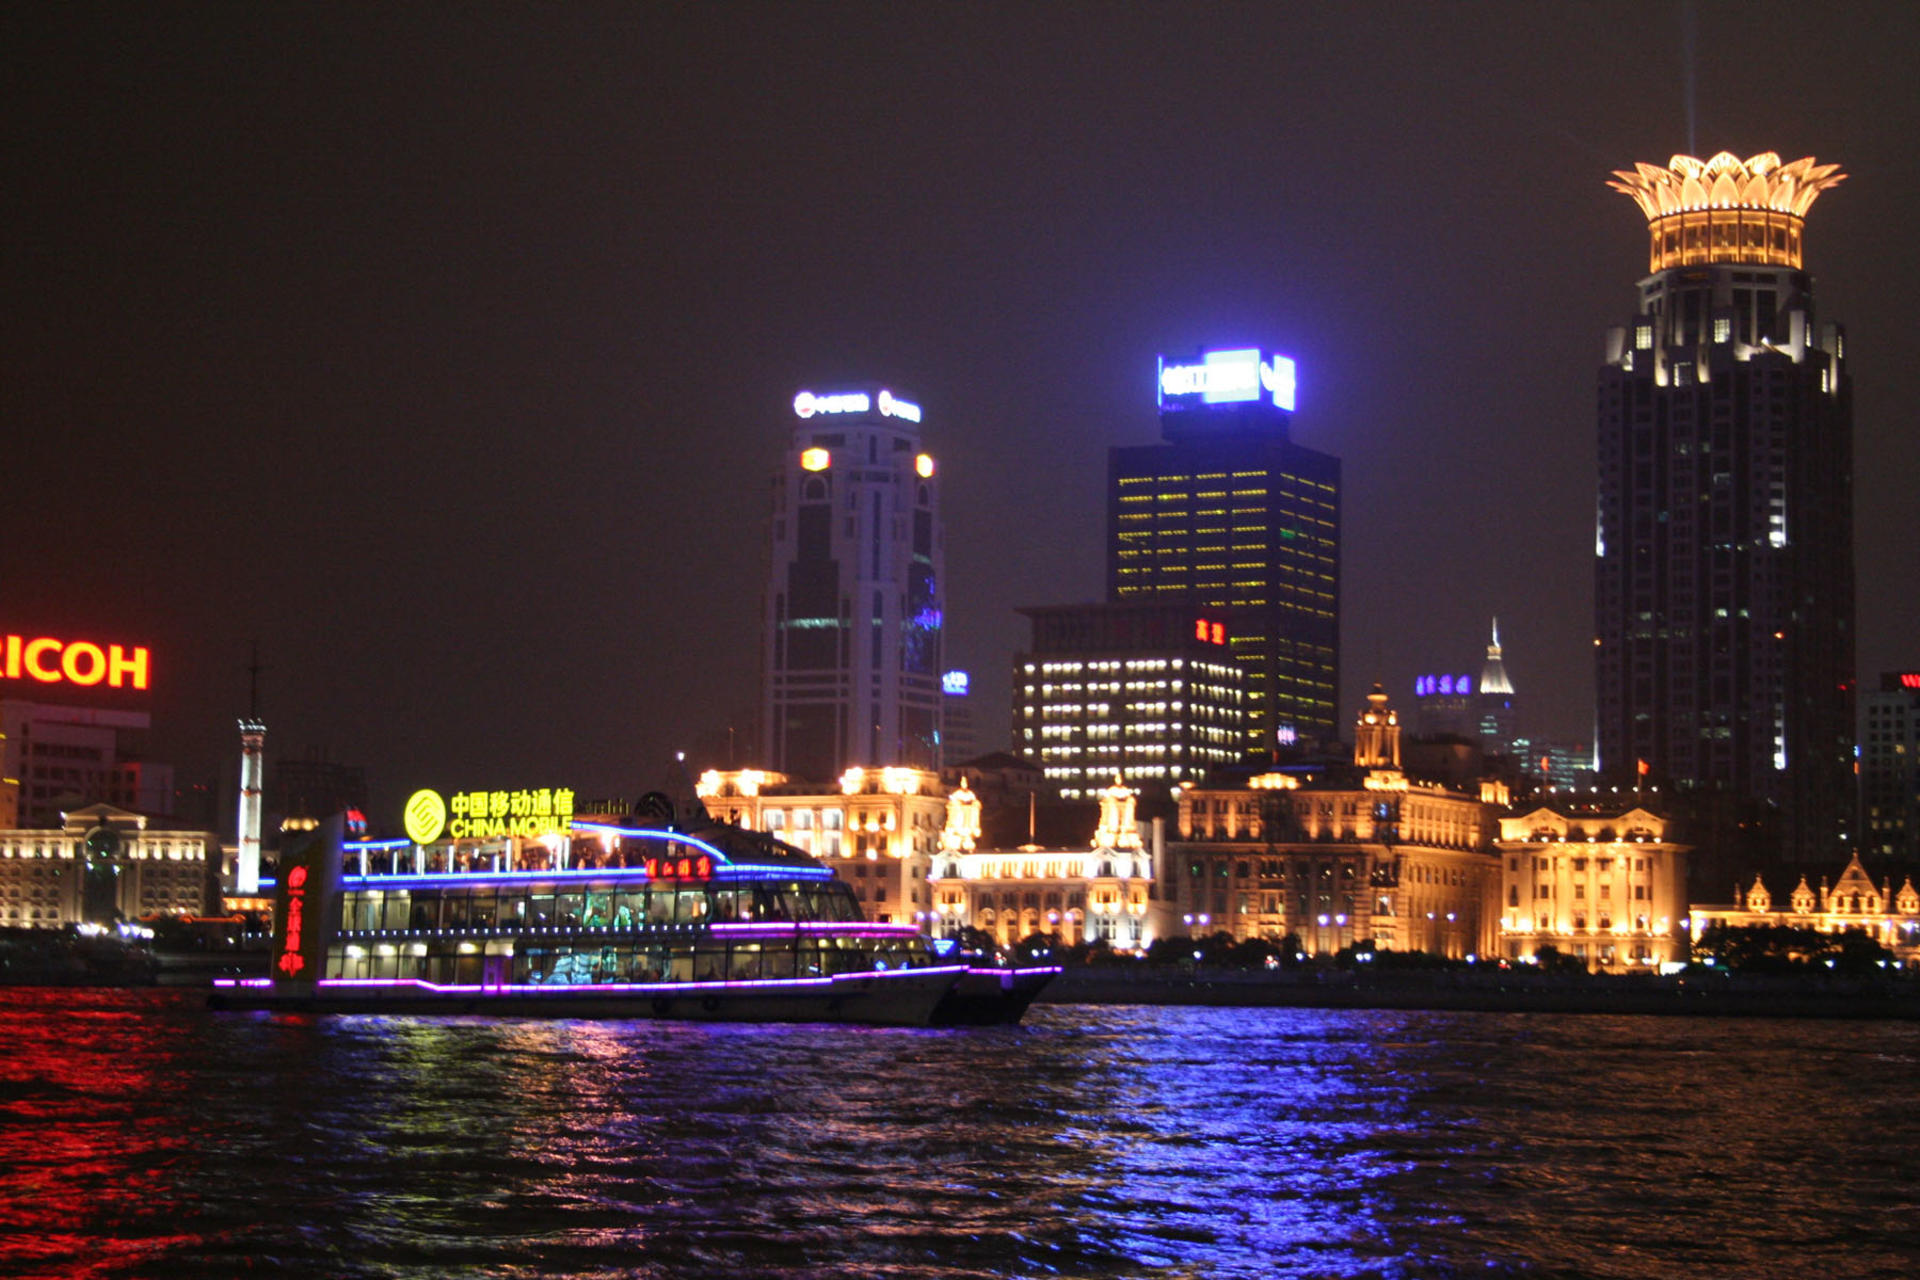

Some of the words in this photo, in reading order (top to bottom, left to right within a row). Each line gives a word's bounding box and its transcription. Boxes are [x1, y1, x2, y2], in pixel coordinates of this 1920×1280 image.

[0, 635, 148, 690] ICOH
[451, 788, 574, 819] 中国移动通信
[450, 817, 507, 838] CHINA
[509, 816, 573, 837] MOBILE
